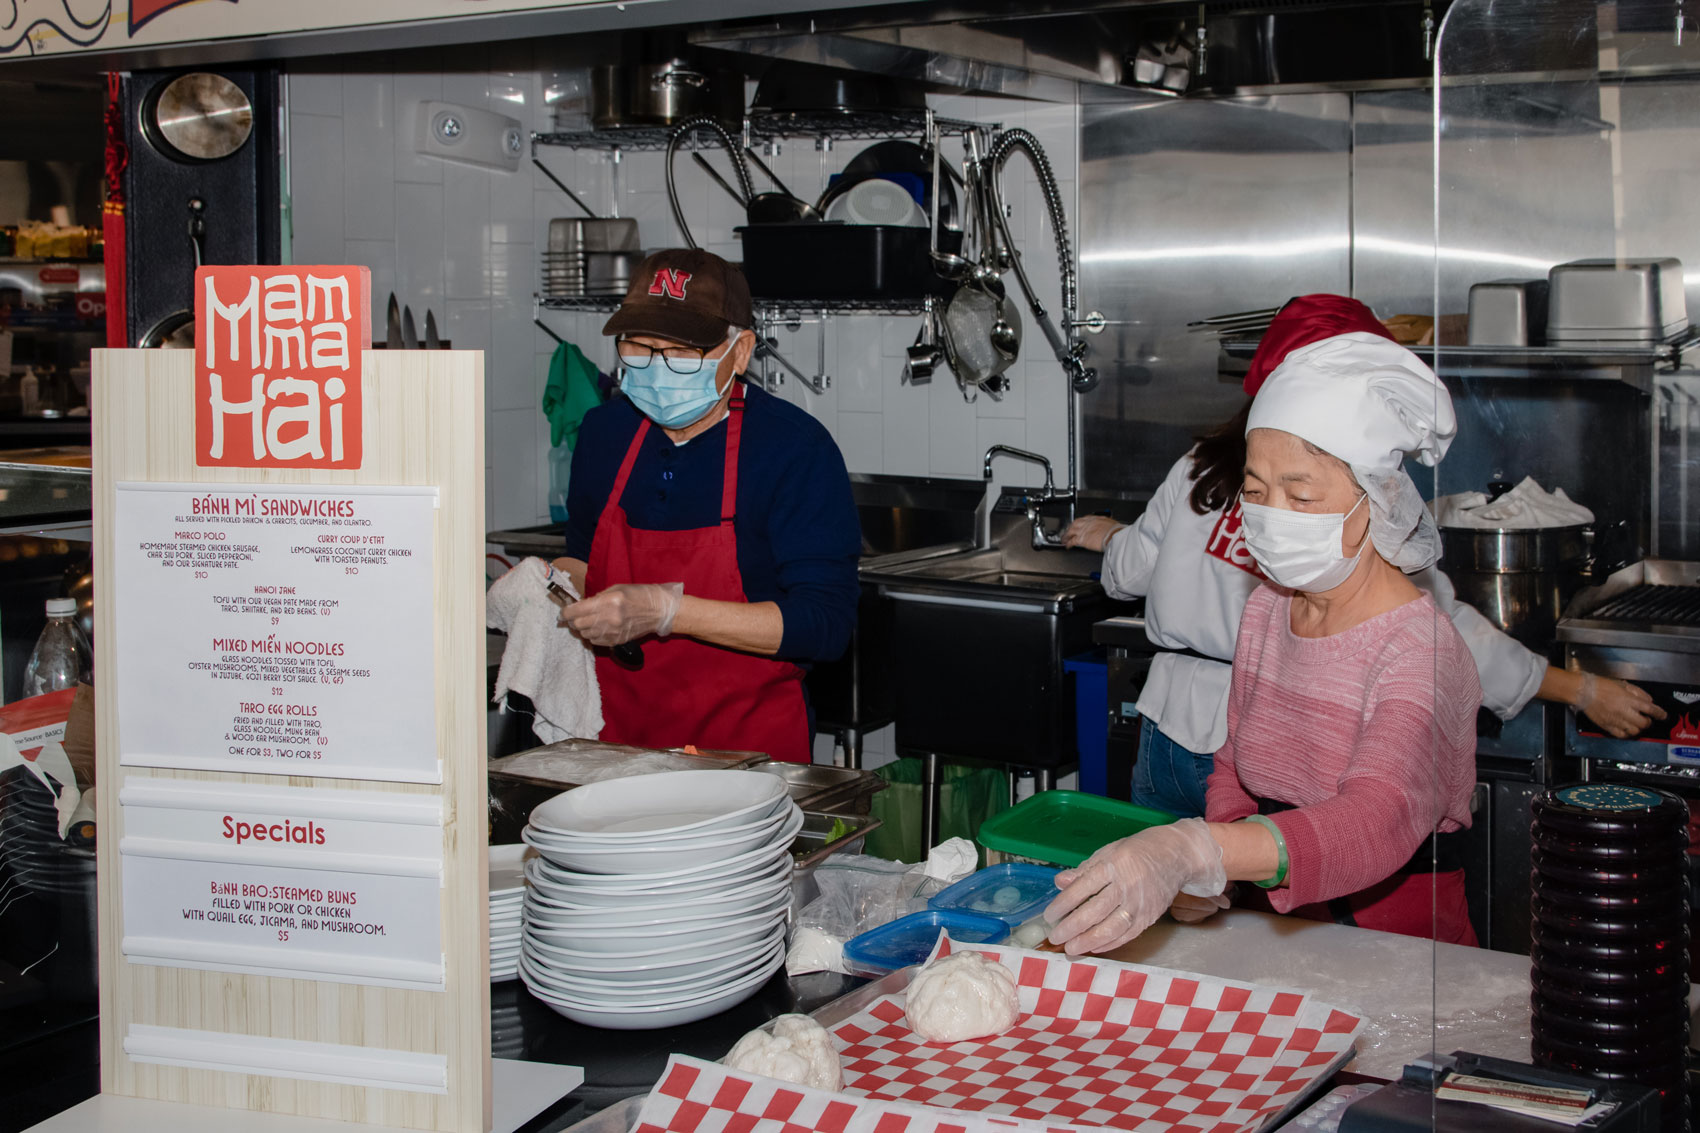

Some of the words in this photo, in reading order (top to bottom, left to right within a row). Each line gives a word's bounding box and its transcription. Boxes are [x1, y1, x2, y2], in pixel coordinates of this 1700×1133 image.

[648, 267, 692, 300] N
[78, 298, 106, 317] Op
[209, 373, 346, 462] Hai
[193, 494, 229, 514] BÁNH
[261, 499, 354, 517] SANDWICHES
[175, 532, 201, 540] MARCO
[204, 532, 225, 540] POLO
[318, 535, 338, 543] CURRY
[341, 535, 360, 543] COUP
[233, 545, 260, 553] SAUSAGE,
[291, 546, 333, 554] LEMONGRASS
[368, 548, 386, 556] CURRY
[195, 571, 208, 579] $10
[345, 567, 358, 575] $10
[255, 586, 276, 594] HANOI
[221, 605, 239, 613] TARO,
[321, 608, 330, 616] (V)
[271, 617, 279, 625] $9
[213, 639, 247, 652] MIXED
[286, 641, 344, 656] NOODLES
[242, 656, 272, 664] NOODLES
[317, 659, 335, 668] TOFU,
[189, 662, 211, 670] OYSTER
[213, 664, 258, 672] MUSHROOMS,
[282, 666, 316, 674] VEGETABLES
[326, 668, 350, 676] SESAME
[272, 687, 283, 695] $12
[240, 702, 264, 714] TARO
[268, 704, 282, 714] EGG
[287, 705, 317, 716] ROLLS
[265, 718, 284, 726] FILLED
[287, 719, 301, 727] WITH
[303, 720, 322, 728] TARO,
[45, 728, 63, 738] BASICS
[269, 736, 311, 745] MUSHROOM.
[317, 737, 328, 745] (V)
[229, 747, 244, 755] ONE
[246, 748, 261, 756] FOR
[263, 748, 273, 757] $3,
[276, 749, 293, 757] TWO
[296, 750, 311, 758] FOR
[313, 751, 321, 759] $5
[223, 816, 325, 844] Specials
[328, 891, 356, 904] BUNS
[213, 898, 240, 909] FILLED
[244, 900, 265, 912] WITH
[269, 902, 294, 913] PORK
[297, 904, 312, 915] OR
[315, 906, 350, 918] CHICKEN
[183, 909, 204, 920] WITH
[207, 911, 236, 923] QUAIL
[239, 914, 256, 926] EGG,
[260, 916, 298, 929] JICAMA,
[302, 919, 318, 930] AND
[321, 921, 386, 936] MUSHROOM.
[278, 931, 288, 941] $5
